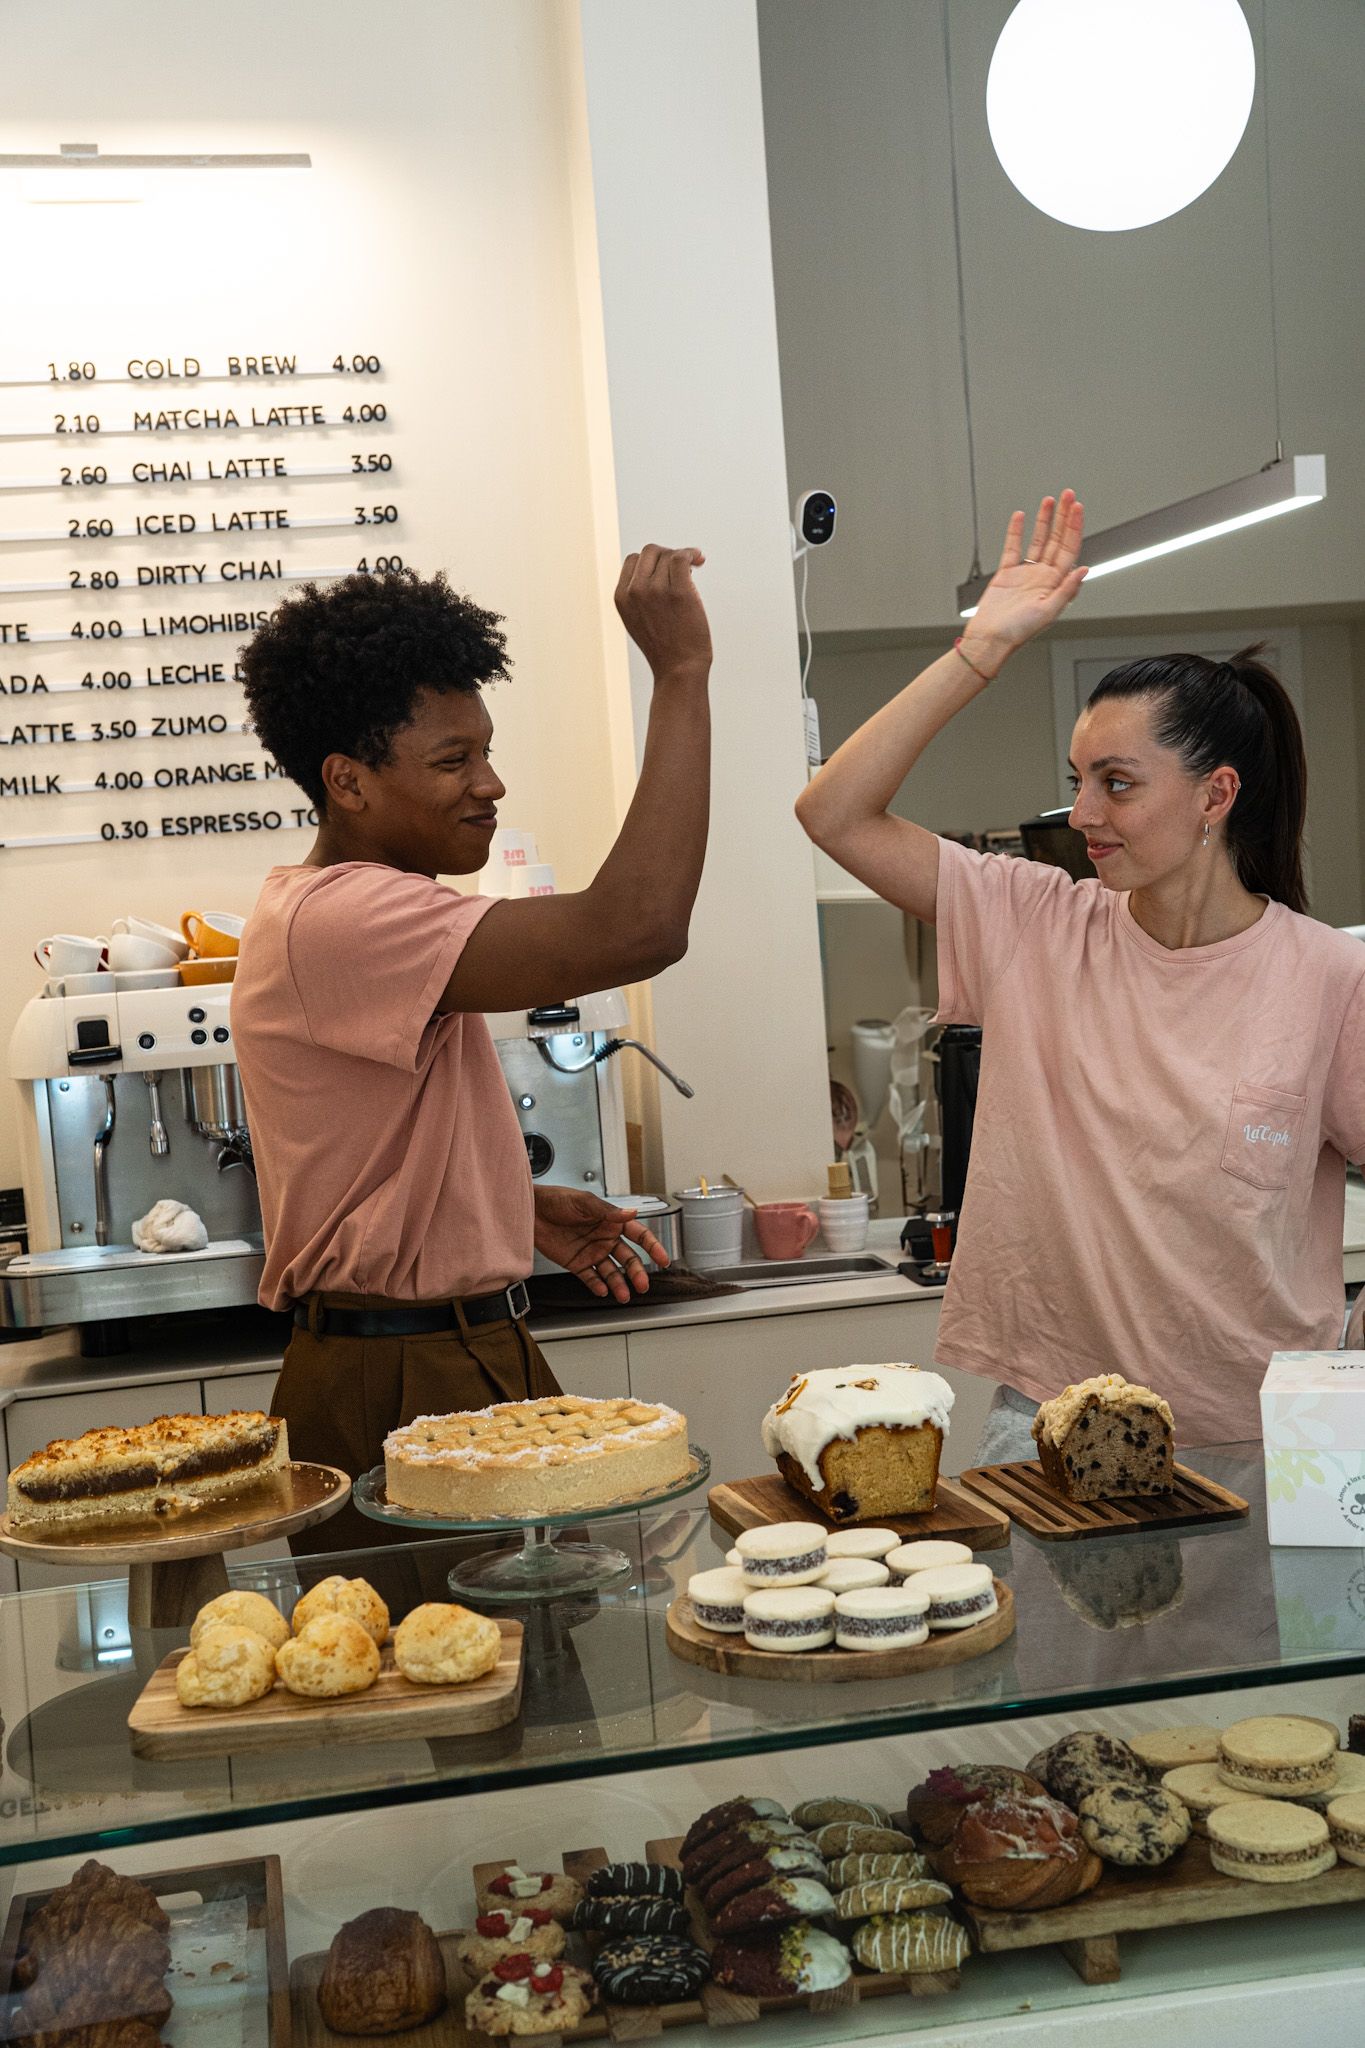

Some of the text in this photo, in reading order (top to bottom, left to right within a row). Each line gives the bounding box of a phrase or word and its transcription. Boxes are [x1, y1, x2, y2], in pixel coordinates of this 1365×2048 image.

[48, 362, 96, 382] 1.80
[127, 355, 381, 381] COLD BREW 4.00
[54, 414, 100, 435] 2.10
[134, 404, 387, 431] MATCHA LATTE 4.00
[60, 466, 107, 487] 2.60
[132, 454, 392, 483] CHAI LATTE 3.50
[68, 519, 114, 539] 2.60
[136, 505, 398, 536] ICED LATTE 3.50
[69, 570, 119, 591] 2.80
[137, 564, 206, 586] DIRTY
[220, 559, 282, 582] CHAI
[71, 620, 123, 640] 4.00
[81, 671, 132, 690] 4.00
[147, 663, 226, 687] LECHE
[91, 719, 137, 742] 3.50
[151, 714, 227, 737] ZUMO
[0, 771, 143, 797] MILK 4.00
[154, 762, 257, 789] ORANGE
[100, 820, 149, 842] 0.30
[161, 811, 282, 837] ESPRESSO
